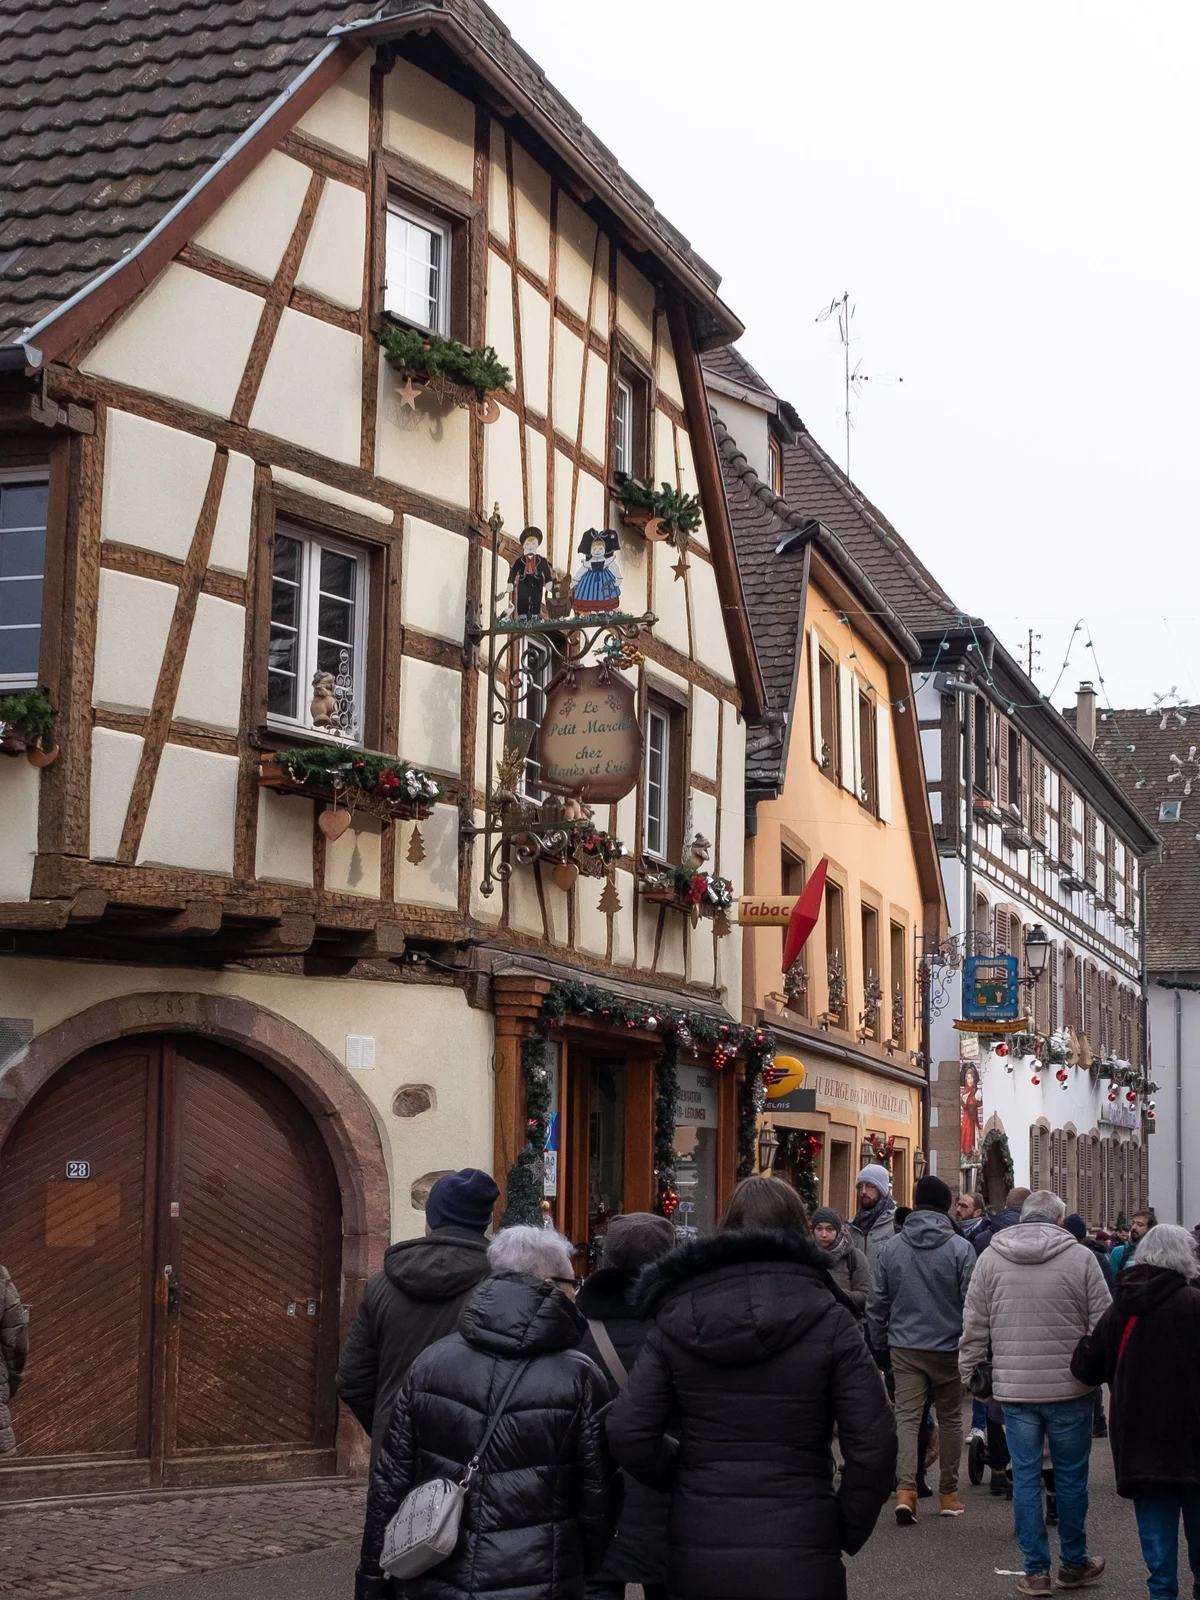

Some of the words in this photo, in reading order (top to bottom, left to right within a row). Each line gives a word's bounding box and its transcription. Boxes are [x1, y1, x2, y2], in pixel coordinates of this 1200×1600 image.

[582, 700, 598, 714] Le
[548, 723, 577, 736] Petit
[575, 745, 603, 760] chez
[589, 763, 600, 775] et
[741, 902, 790, 916] Tabac
[815, 1075, 850, 1101] AUBERGE
[860, 1087, 878, 1107] TROIS
[69, 1163, 87, 1176] 28
